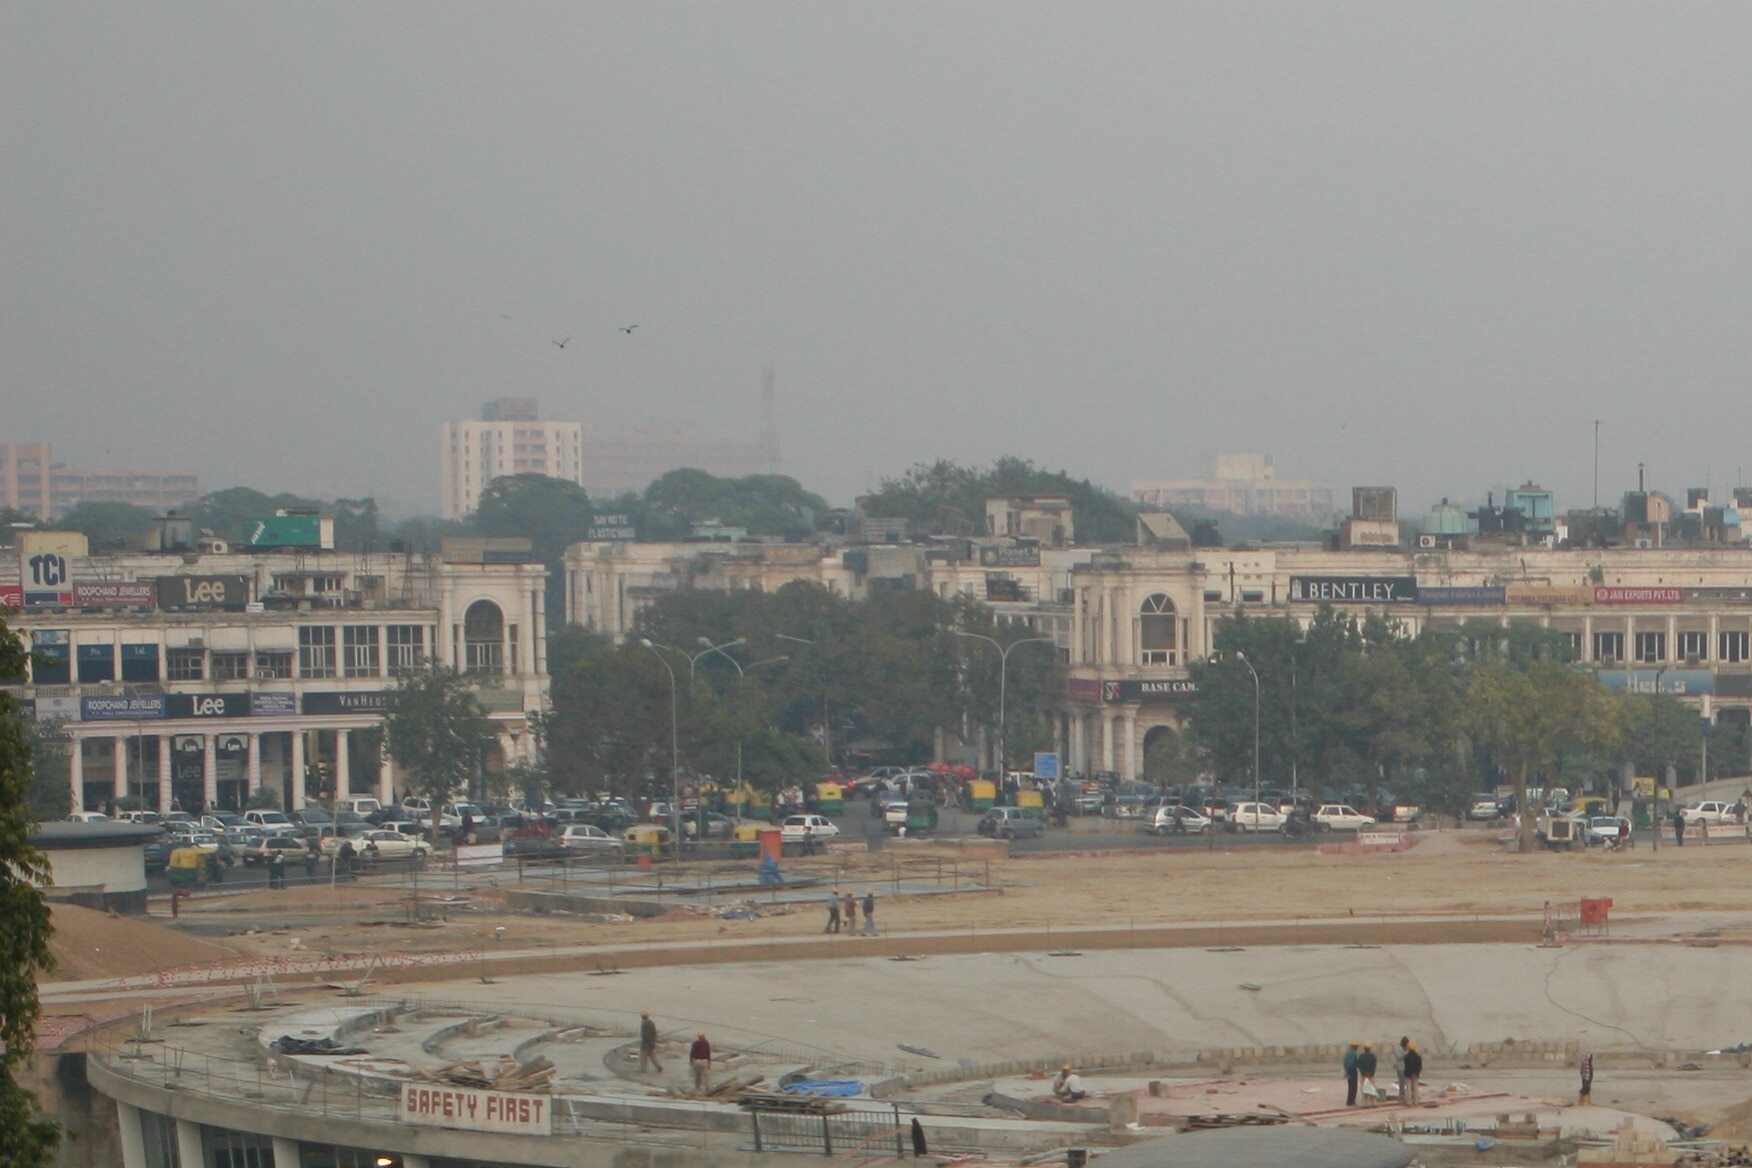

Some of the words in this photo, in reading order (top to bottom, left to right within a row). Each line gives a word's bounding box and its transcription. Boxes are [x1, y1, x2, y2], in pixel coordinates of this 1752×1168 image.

[29, 553, 66, 586] TCI
[77, 586, 118, 597] ROOPCHAND
[119, 586, 151, 597] JEWELLERS
[183, 578, 226, 604] Lee
[1309, 582, 1395, 600] BENTLEY
[1624, 589, 1653, 600] EXPORTS
[1141, 682, 1171, 692] BASE
[1172, 682, 1199, 692] CAM
[88, 700, 128, 711] ROOPCHAND
[129, 699, 162, 710] JEWELLERS
[192, 695, 225, 715] Lee
[184, 743, 197, 752] Lee
[227, 743, 241, 751] Lee
[176, 765, 201, 779] Lee
[407, 1087, 478, 1118] SAFETY
[487, 1095, 544, 1124] FIRST
